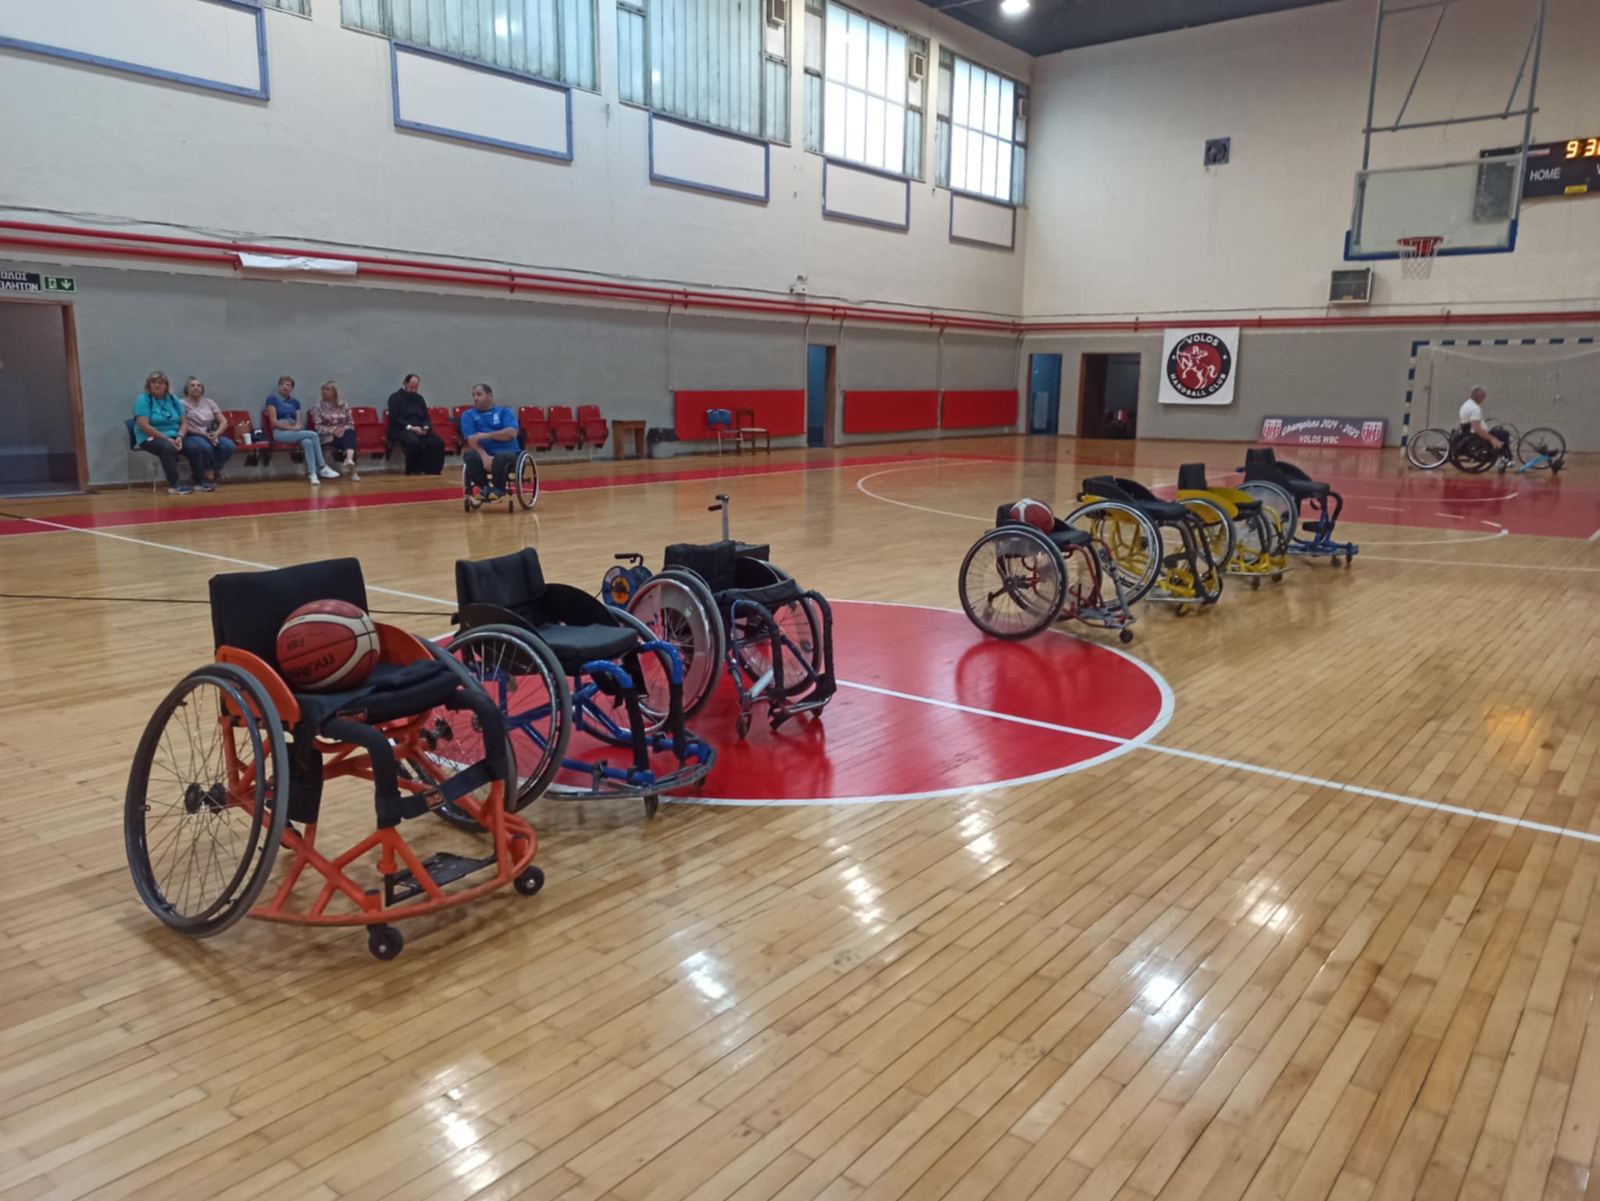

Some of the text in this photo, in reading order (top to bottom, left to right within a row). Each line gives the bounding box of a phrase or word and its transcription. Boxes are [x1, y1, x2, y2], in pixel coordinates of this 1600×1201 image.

[1529, 167, 1561, 181] HOME
[1186, 334, 1219, 346] VOLOS
[1170, 373, 1227, 397] HANDBALL CLUB
[1300, 435, 1339, 444] VOLOS WBC
